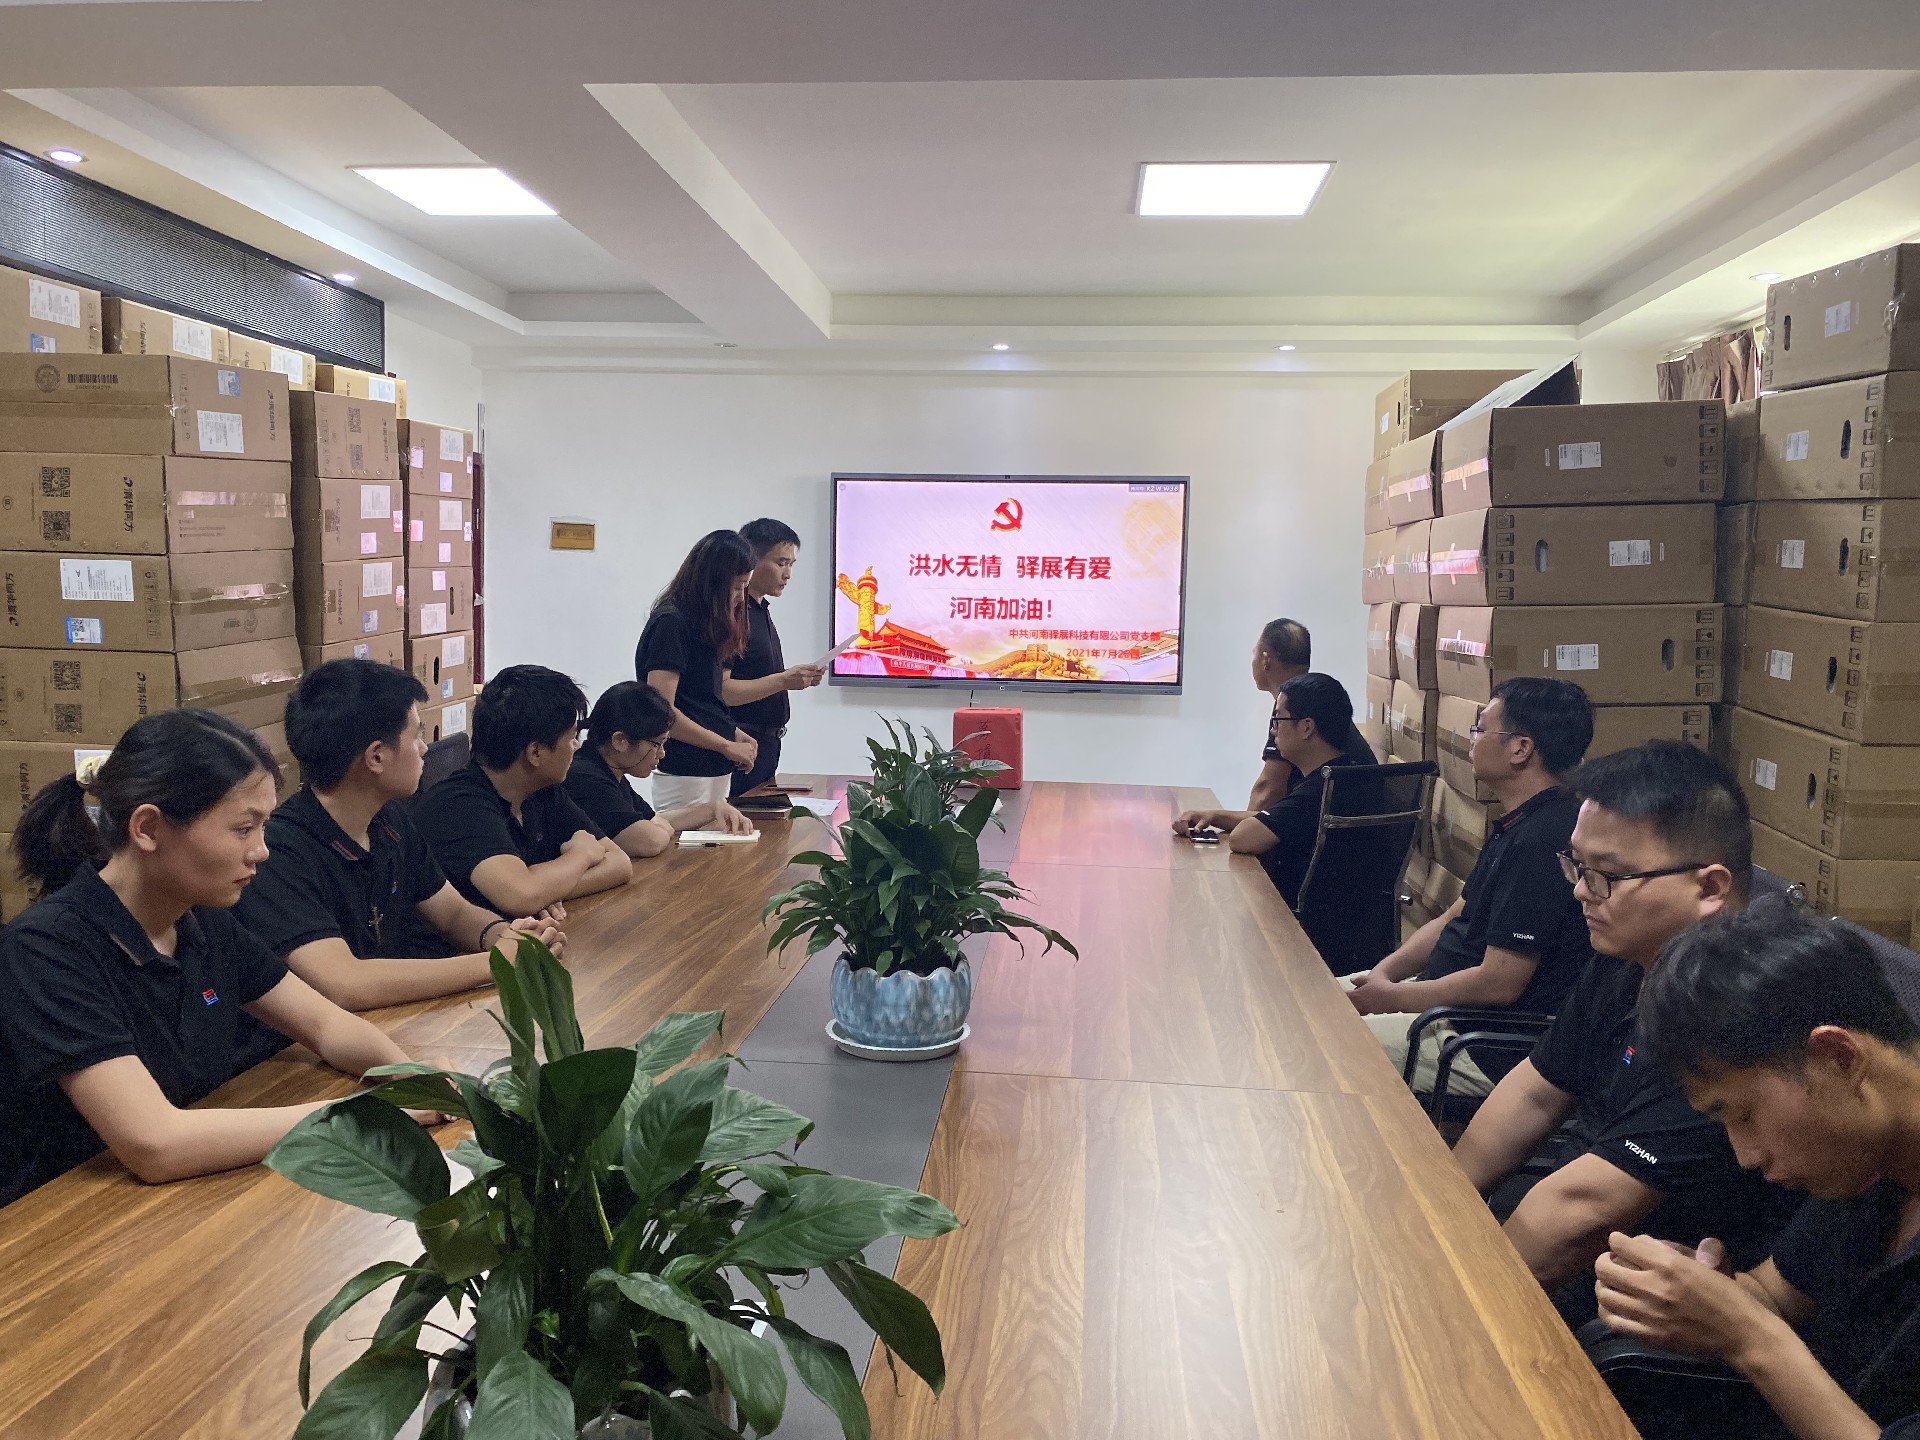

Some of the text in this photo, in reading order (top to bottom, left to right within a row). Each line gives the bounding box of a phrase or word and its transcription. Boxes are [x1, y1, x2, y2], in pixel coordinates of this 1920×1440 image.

[124, 488, 134, 532] 清华同方
[909, 553, 1111, 580] 洪水无情 驿展有爱
[5, 572, 17, 616] 清华同方
[137, 683, 147, 715] 清华同
[1512, 932, 1535, 940] YIZHAN
[1624, 1139, 1658, 1165] YIZHAN
